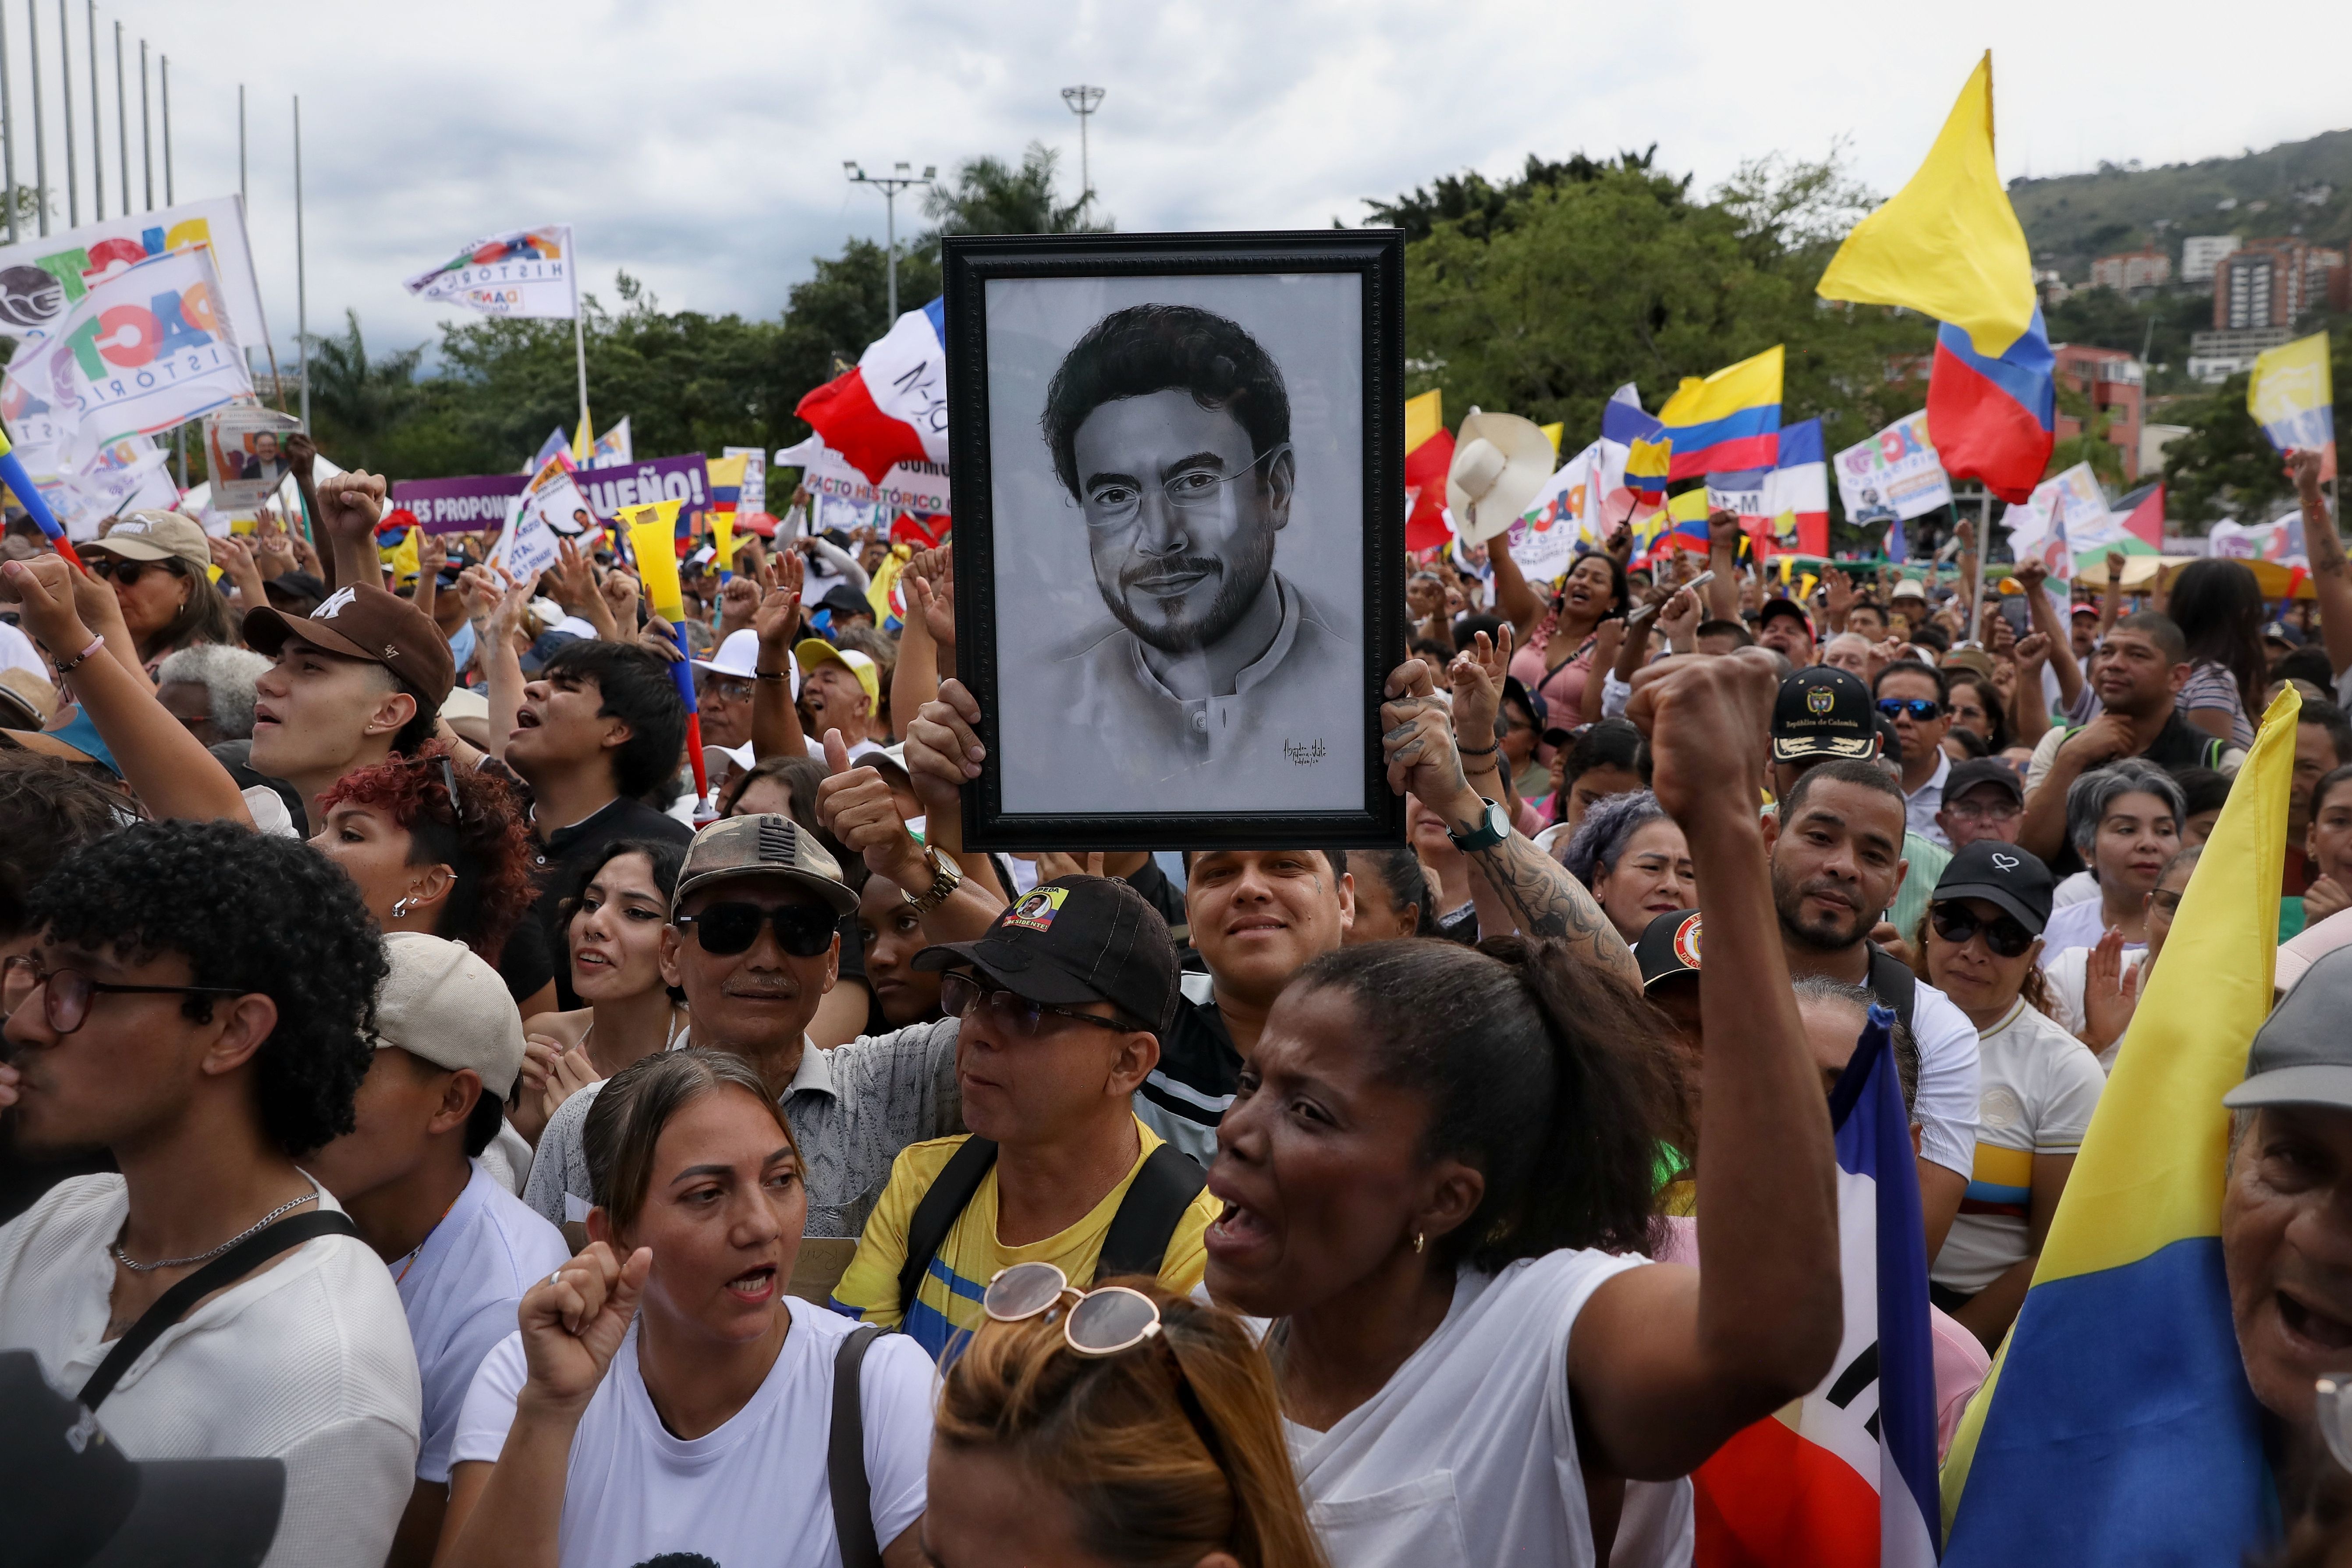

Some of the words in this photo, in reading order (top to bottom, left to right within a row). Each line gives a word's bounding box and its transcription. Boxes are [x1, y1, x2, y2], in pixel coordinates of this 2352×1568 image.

[434, 494, 510, 523] PROPON
[580, 465, 706, 519] UEÑO!
[807, 473, 852, 496] PACTO
[855, 483, 941, 511] HISTÓRICO
[309, 585, 356, 620] NY
